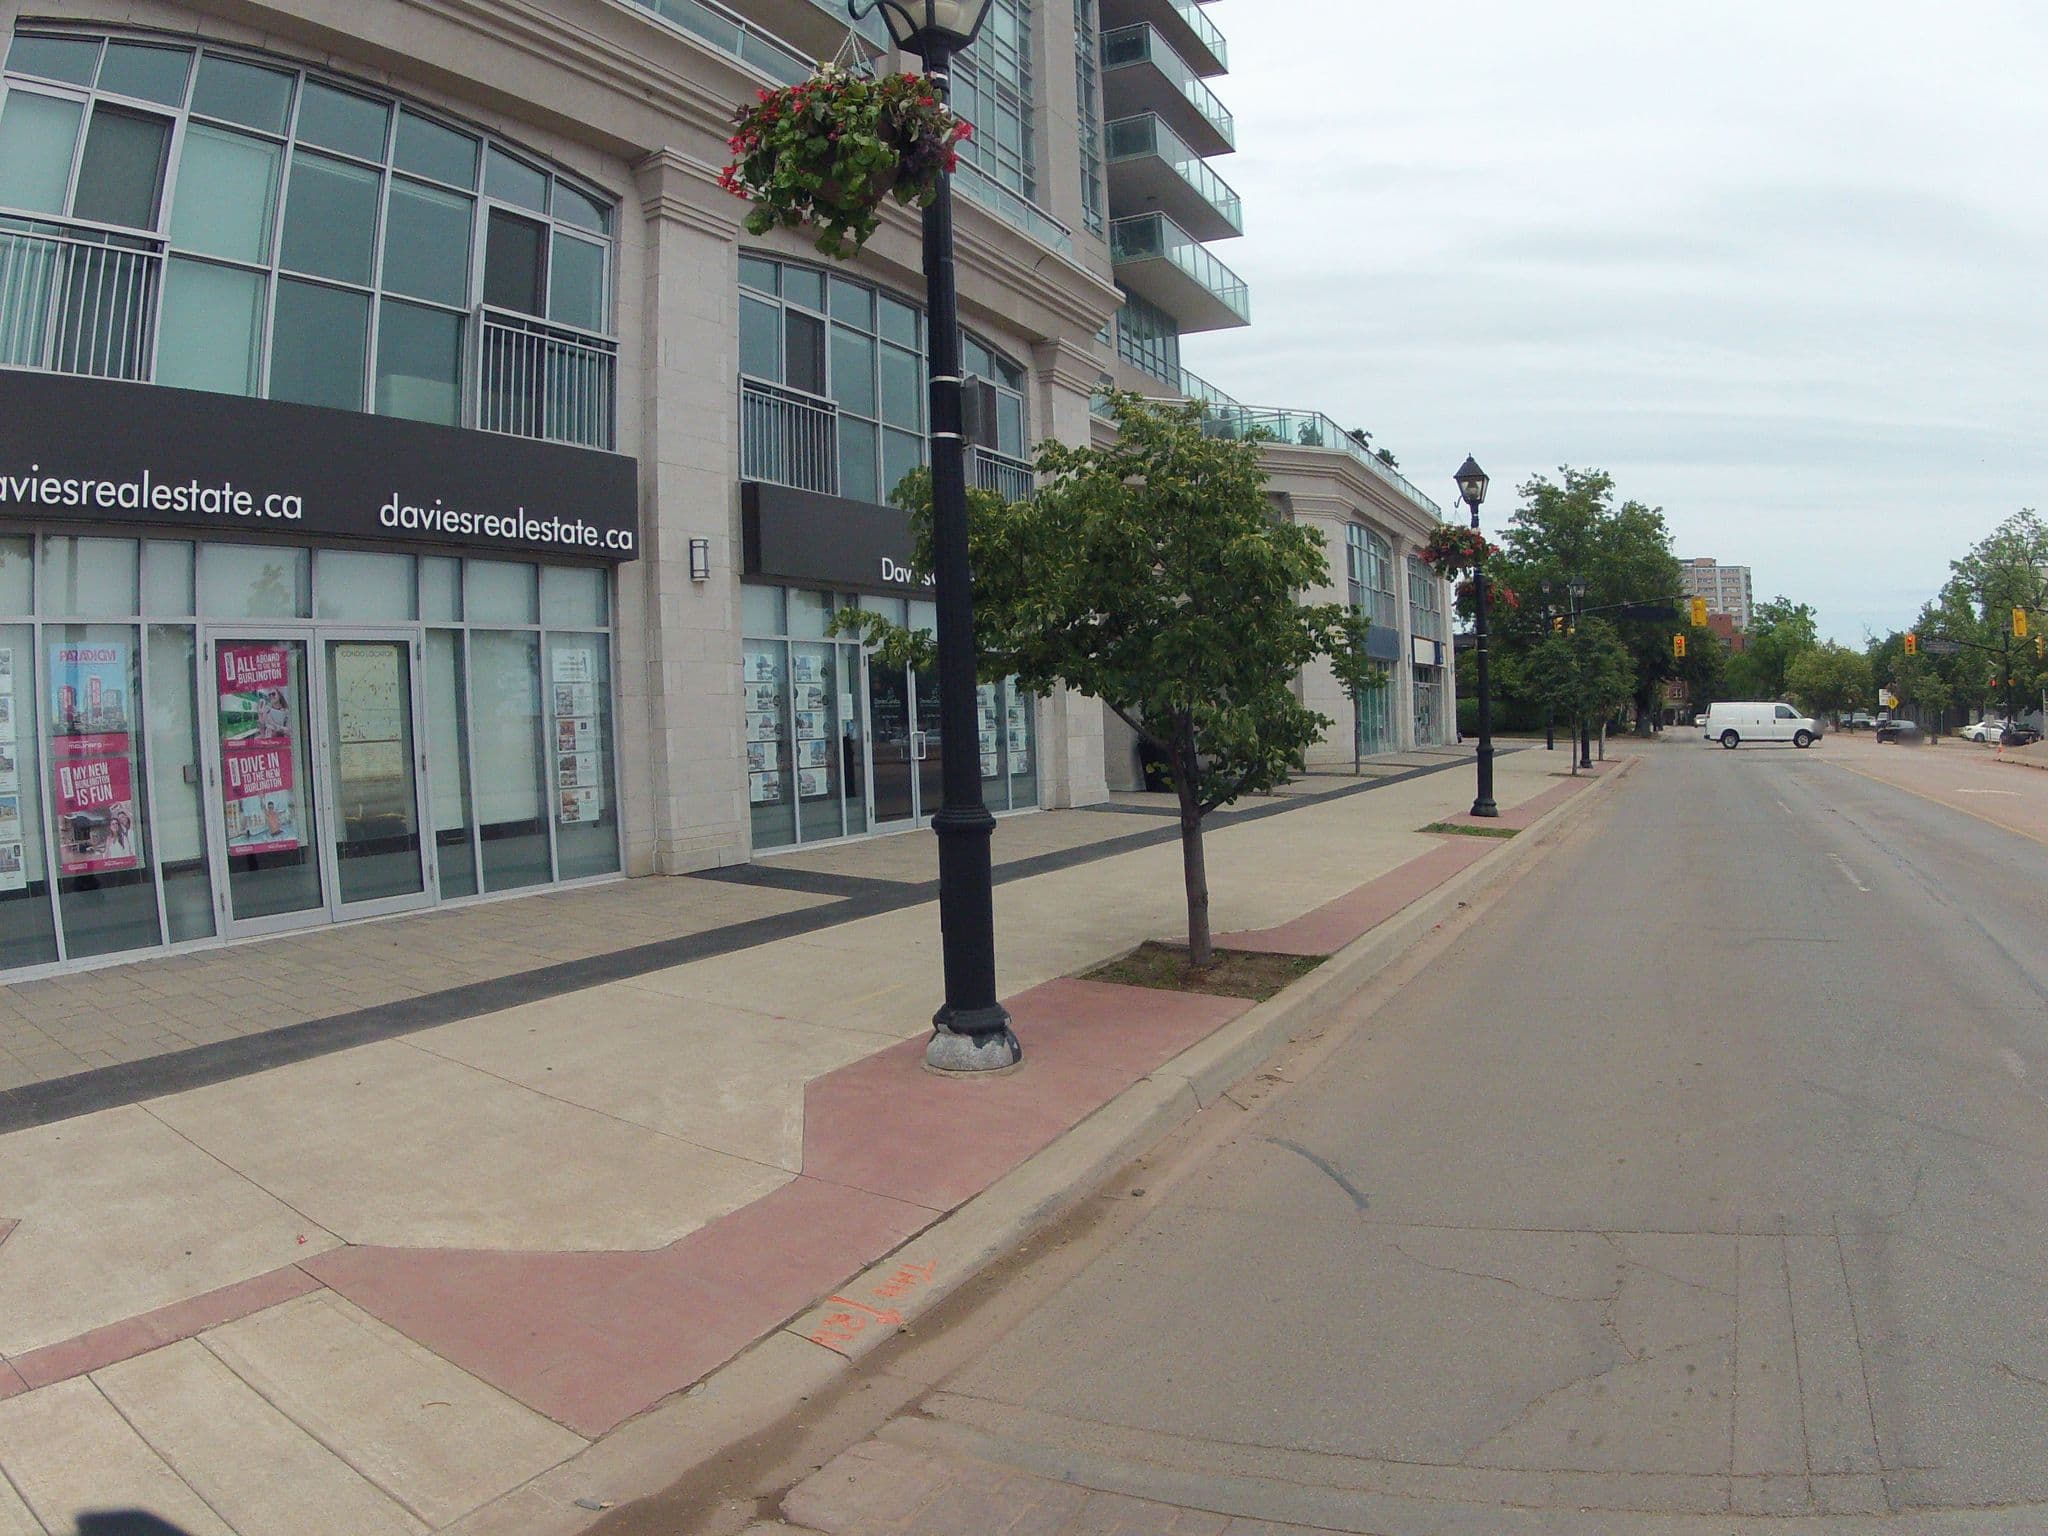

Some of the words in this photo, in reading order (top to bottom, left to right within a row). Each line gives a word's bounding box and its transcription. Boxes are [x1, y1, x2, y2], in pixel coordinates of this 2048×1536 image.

[379, 492, 633, 550] daviesrealestate.ca
[237, 656, 256, 673] ALL
[237, 668, 282, 684] BURLINGTON
[72, 766, 88, 780] MY
[88, 762, 109, 777] NEW
[240, 754, 265, 774] DIVE
[267, 752, 280, 768] IN
[243, 773, 252, 784] TO
[252, 771, 264, 782] THE
[265, 768, 281, 779] NEW
[243, 778, 282, 793] BURLINGTON
[76, 788, 89, 806] IS
[90, 783, 113, 804] FUN
